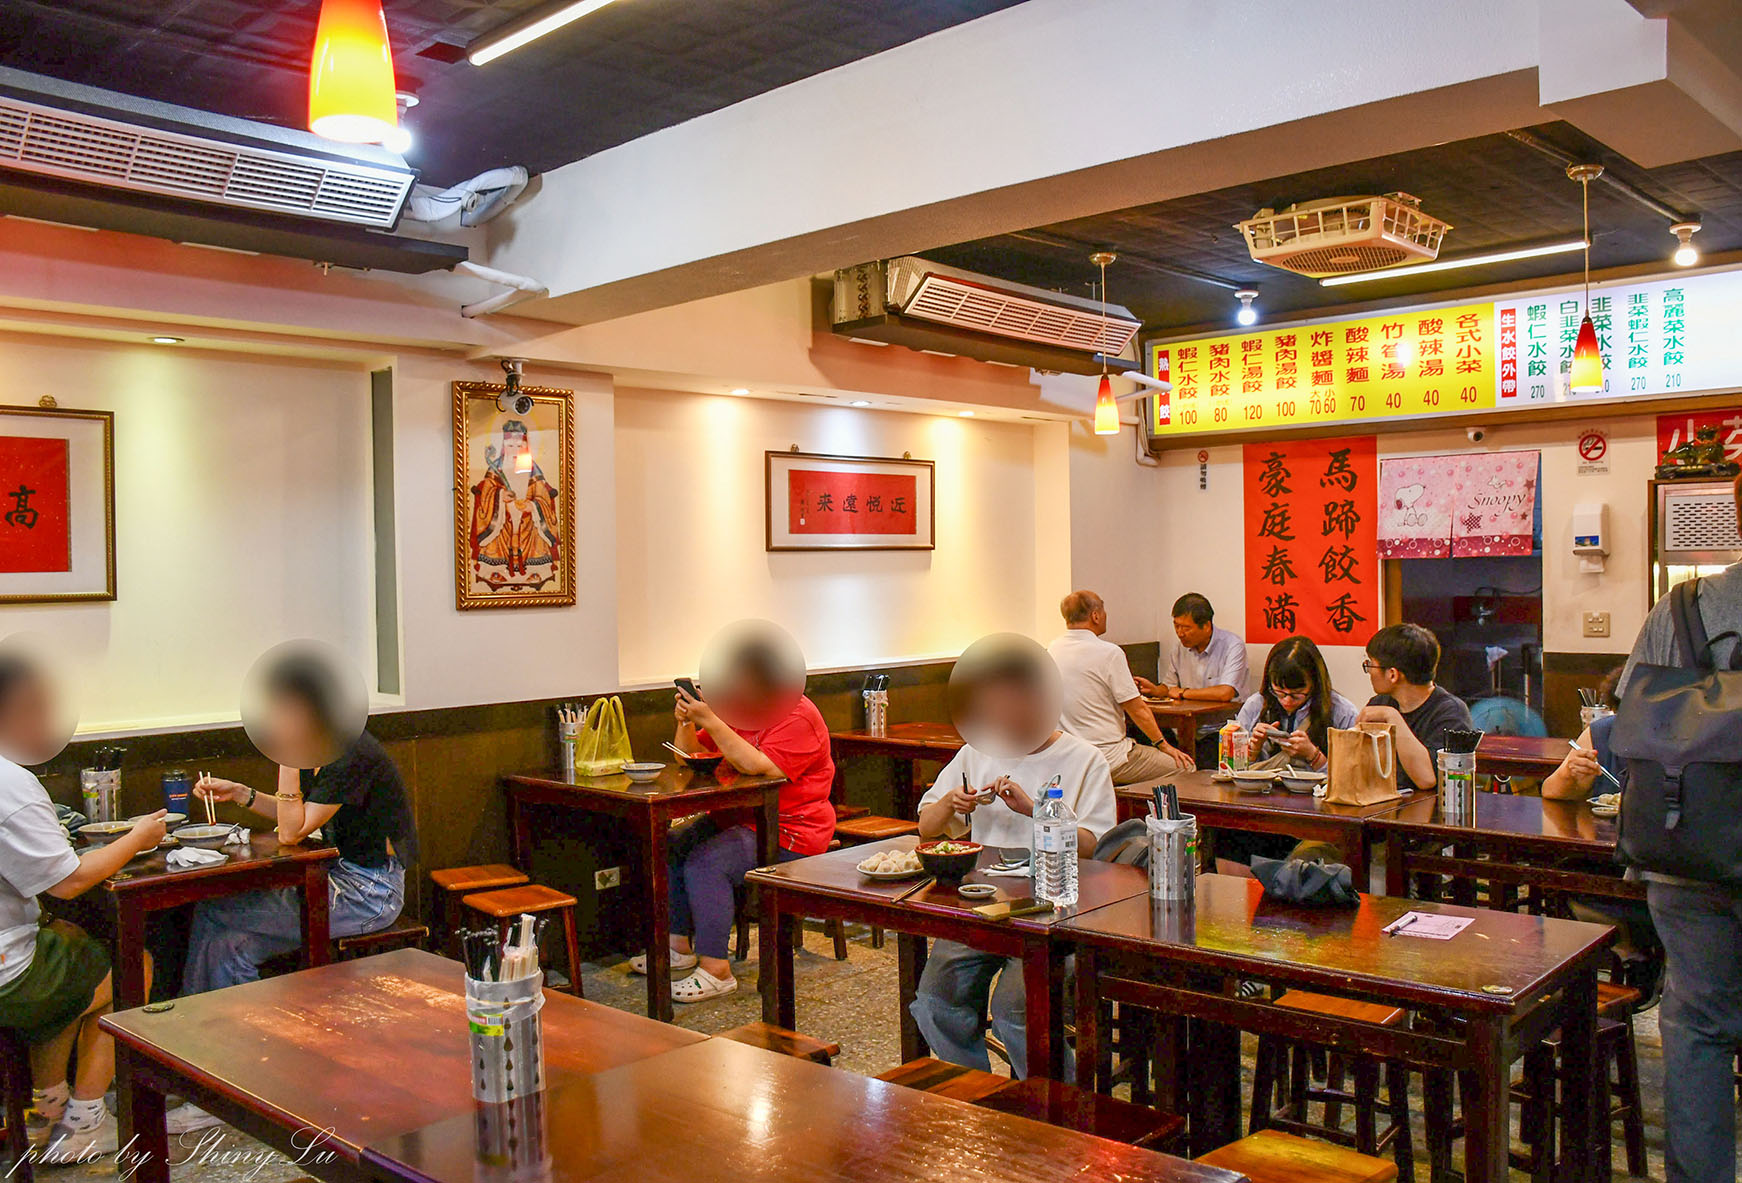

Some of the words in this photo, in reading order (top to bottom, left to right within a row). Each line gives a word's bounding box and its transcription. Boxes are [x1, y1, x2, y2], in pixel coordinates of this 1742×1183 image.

[1418, 318, 1444, 377] 酸辣湯
[1456, 313, 1482, 374] 各式小菜
[1527, 304, 1547, 377] 蝦仁水餃
[1628, 292, 1648, 369] 韭菜蝦仁水餃
[1663, 287, 1685, 366] 高麗菜水餃
[1178, 347, 1198, 400] 蝦仁水餃
[1209, 343, 1230, 397] 豬肉水餃
[1241, 339, 1263, 393] 蝦仁湯餃
[1275, 334, 1297, 390] 豬肉湯餃
[1310, 331, 1334, 387] 炸醬麵
[1345, 326, 1369, 384] 酸辣麵
[1501, 313, 1516, 393] 生水餃外帶
[1158, 357, 1170, 419] 熱餃
[1324, 388, 1335, 397] 小
[1350, 395, 1365, 411] 70
[1386, 392, 1401, 408] 40
[1423, 389, 1439, 406] 40
[1460, 386, 1477, 403] 40
[1530, 385, 1545, 399] 270
[1631, 376, 1646, 391] 270
[1666, 373, 1681, 388] 210
[1180, 410, 1197, 425] 100
[1214, 407, 1227, 422] 80
[1244, 404, 1262, 420] 120
[1276, 401, 1295, 417] 100
[1309, 399, 1321, 415] 70
[1324, 398, 1336, 413] 60
[5, 485, 39, 529] 高
[1468, 492, 1526, 517] Snoopy
[1257, 451, 1299, 633] 豪庭春滿
[1318, 448, 1367, 633] 馬蹄餃香
